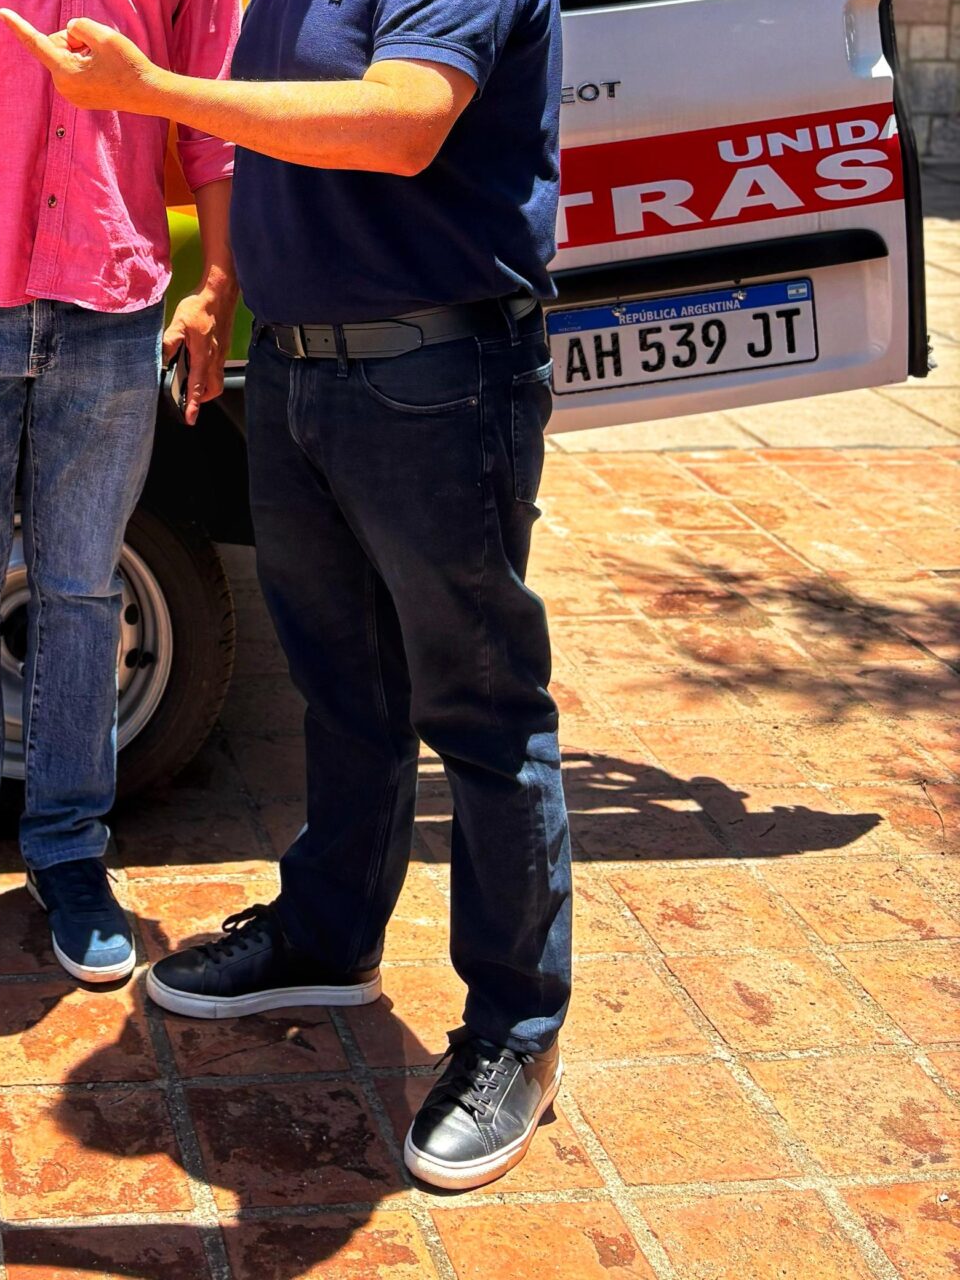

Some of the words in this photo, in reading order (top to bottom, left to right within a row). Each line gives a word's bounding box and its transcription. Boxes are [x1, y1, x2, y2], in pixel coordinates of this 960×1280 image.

[619, 308, 677, 325] REPÚBLICA
[680, 299, 741, 317] ARGENTINA
[565, 331, 623, 384] AH
[638, 319, 728, 373] 539
[746, 308, 802, 359] JT
